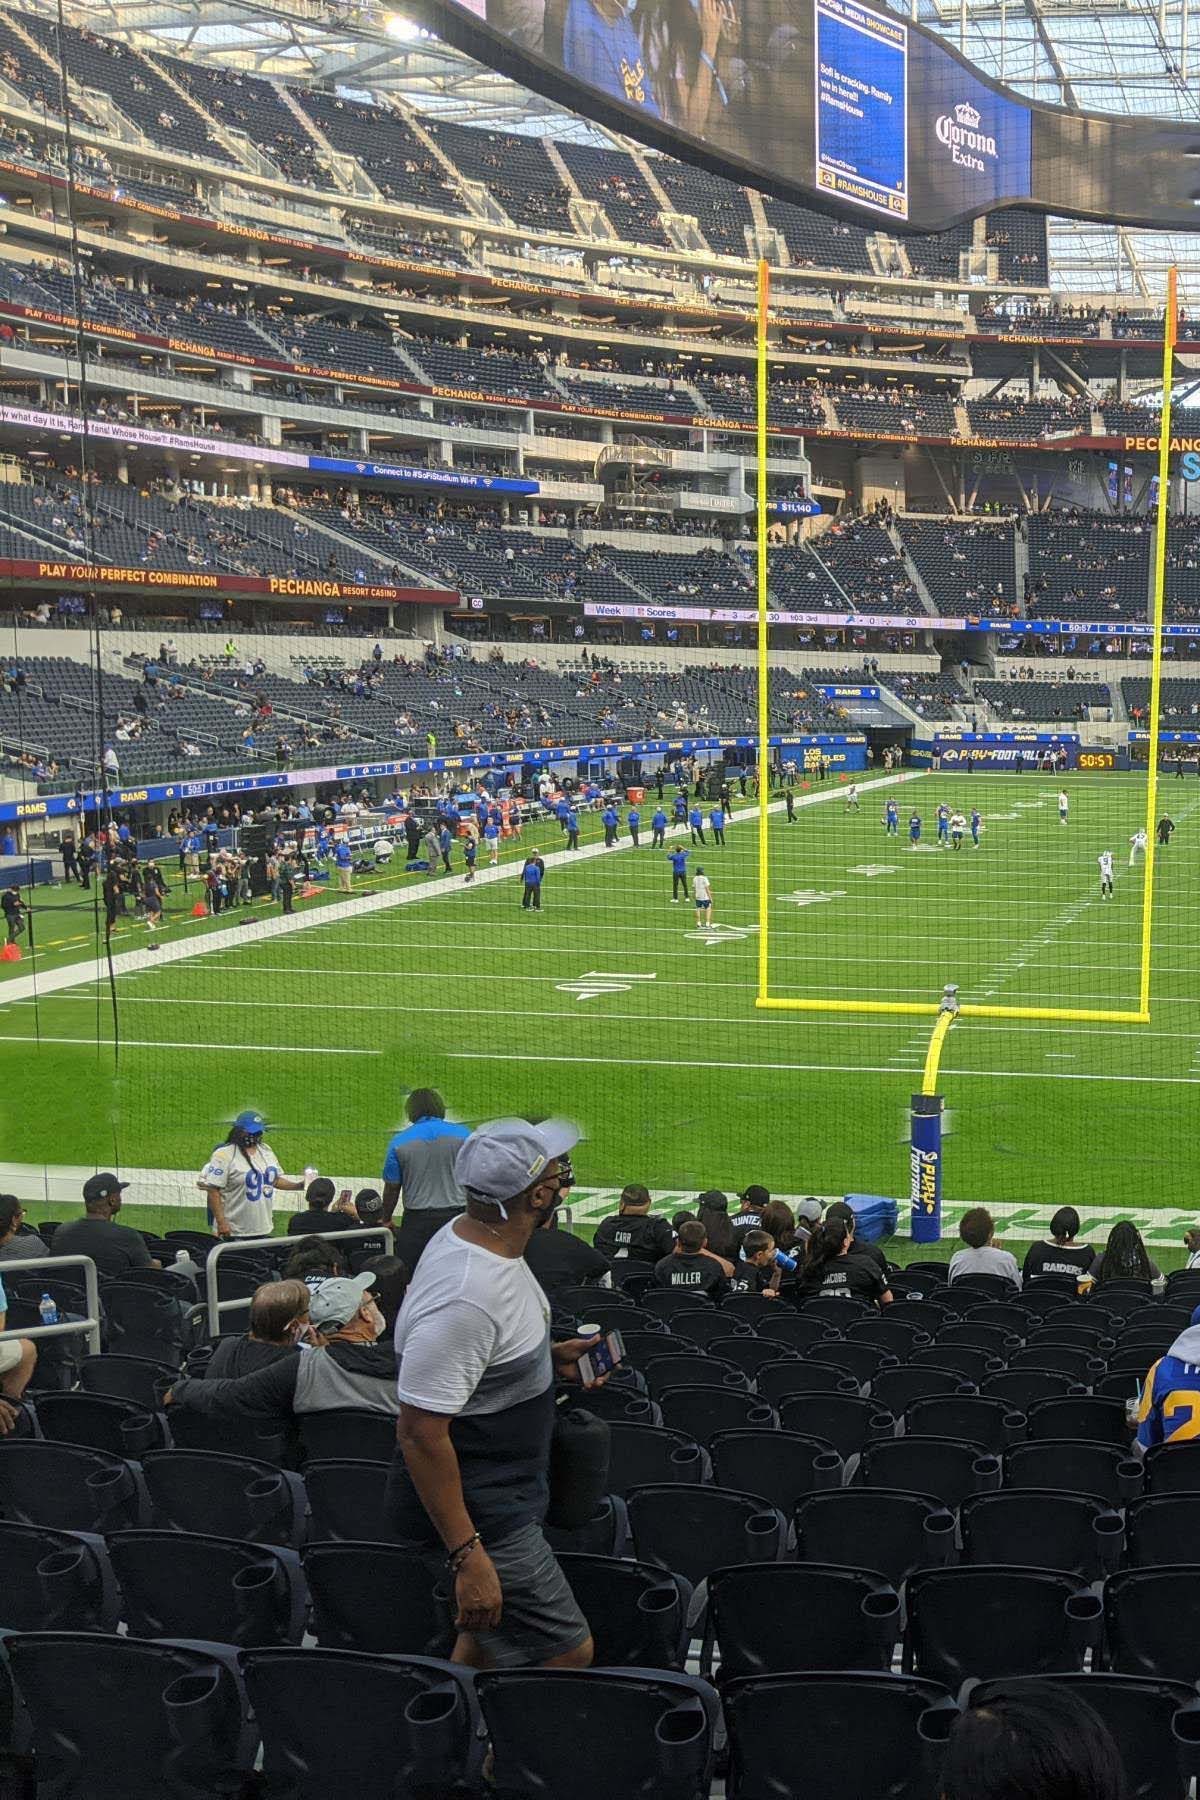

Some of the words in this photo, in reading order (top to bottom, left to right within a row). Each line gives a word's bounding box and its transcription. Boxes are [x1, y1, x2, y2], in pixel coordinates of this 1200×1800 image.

[844, 6, 866, 24] MEDIA
[866, 17, 903, 41] SHOWCASE
[935, 115, 996, 155] Corona
[951, 145, 985, 172] Extra
[75, 183, 91, 194] PLAY
[837, 177, 888, 205] #RAMSHOUSE
[217, 221, 271, 240] PECHANGA
[348, 253, 363, 263] PLAY
[381, 259, 410, 270] PERFECT
[411, 263, 456, 277] COMBINATION
[491, 279, 539, 293] PECHANGA
[649, 302, 675, 310] PERFECT
[676, 305, 720, 315] COMBINATION
[24, 308, 42, 318] PLAY
[44, 312, 62, 322] YOUR
[92, 321, 137, 339] COMBINATION
[899, 329, 924, 337] PERFECT
[926, 330, 966, 339] COMBINATION
[998, 335, 1044, 344] PECHANGA
[168, 340, 216, 358] PECHANGA
[294, 365, 311, 374] PLAY
[330, 370, 357, 381] PERFECT
[357, 374, 400, 388] COMBINATION
[432, 387, 483, 401] PECHANGA
[561, 404, 577, 412] PLAY
[594, 408, 620, 417] PERFECT
[620, 411, 664, 421] COMBINATION
[693, 418, 740, 429] PECHANGA
[11, 412, 31, 423] what
[33, 415, 48, 427] day
[111, 425, 137, 438] Whose
[169, 433, 216, 451] #RamsHouse
[850, 432, 876, 440] PERFECT
[877, 433, 918, 442] COMBINATION
[951, 438, 998, 447] PECHANGA
[373, 465, 403, 477] Connect
[404, 469, 411, 478] to
[412, 470, 459, 482] #SoFiStadium
[460, 476, 477, 486] Wi-Fi
[782, 502, 812, 513] $11,140
[39, 564, 67, 577] PLAY
[69, 566, 99, 579] YOUR
[101, 568, 146, 582] PERFECT
[149, 571, 217, 587] COMBINATION
[270, 578, 341, 597] PECHANGA
[342, 586, 369, 596] RESORT
[370, 588, 397, 598] CASINO
[595, 605, 621, 615] Week
[646, 607, 676, 617] Scores
[769, 613, 780, 621] 30
[444, 758, 463, 767] RAMS
[1079, 754, 1113, 767] 50:57
[120, 790, 148, 802] RAMS
[16, 802, 47, 815] RAMS
[244, 1166, 278, 1202] 99
[615, 1230, 632, 1244] CARR
[1042, 1261, 1084, 1277] RAIDERS
[671, 1271, 701, 1286] WALLER
[822, 1271, 847, 1286] JACOBS
